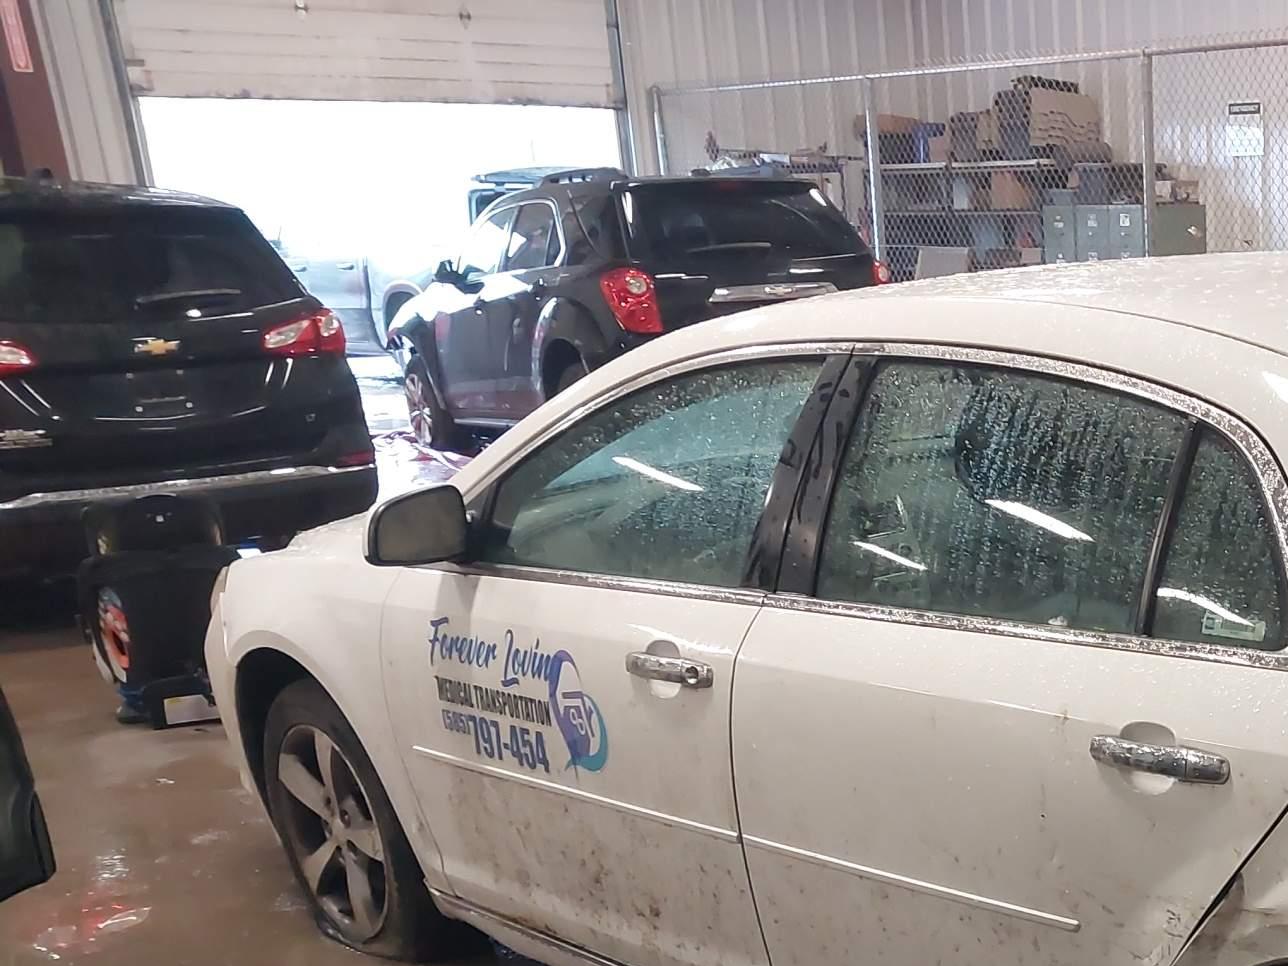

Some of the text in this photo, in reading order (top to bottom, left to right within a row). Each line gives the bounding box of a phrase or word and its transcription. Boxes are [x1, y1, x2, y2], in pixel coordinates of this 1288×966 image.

[429, 616, 497, 669] Forever
[435, 675, 552, 727] MEDICAL TRANSPORTATION
